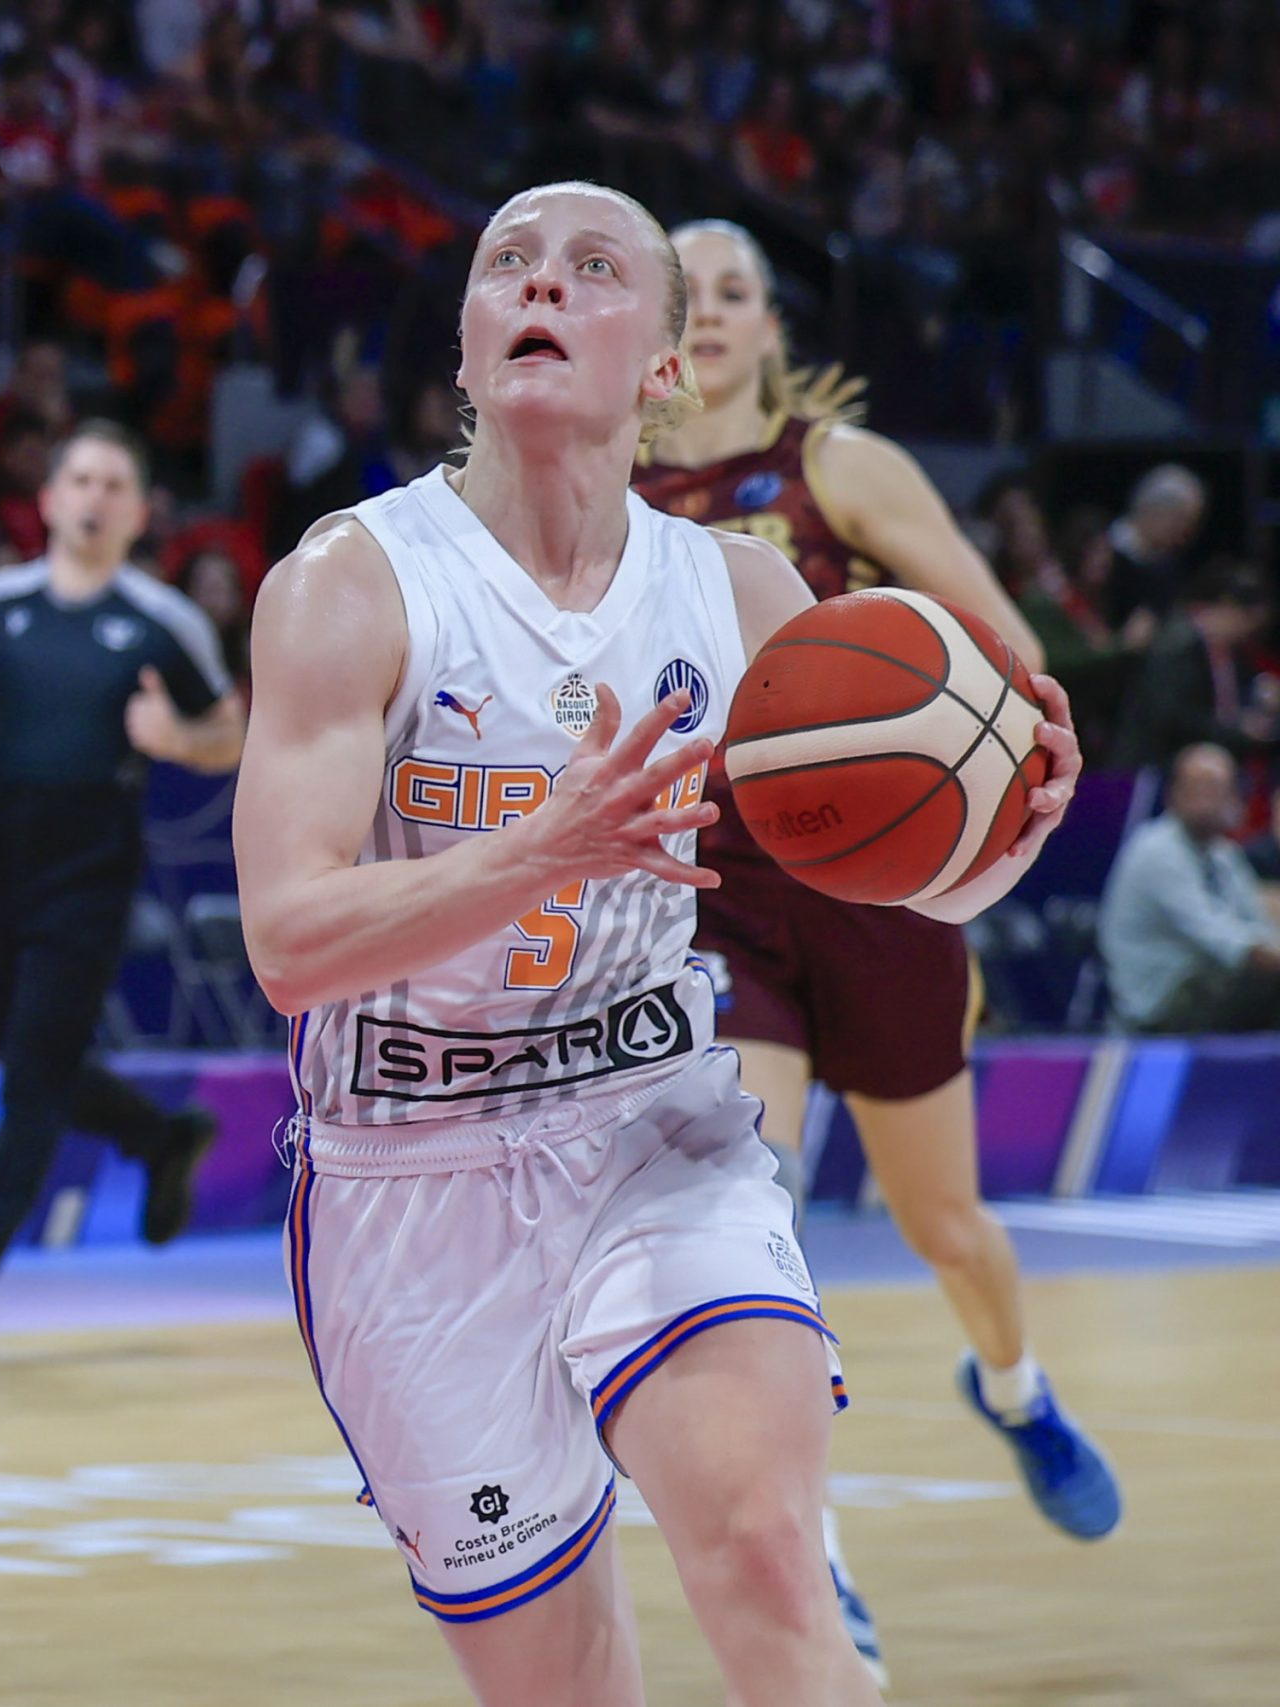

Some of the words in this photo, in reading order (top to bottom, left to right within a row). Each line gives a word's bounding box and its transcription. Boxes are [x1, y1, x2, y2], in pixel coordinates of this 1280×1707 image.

[555, 710, 596, 725] GIRON
[557, 698, 595, 710] BASQUET
[504, 878, 589, 992] 5
[377, 1018, 605, 1086] SPAR
[478, 1492, 502, 1515] G!
[443, 1549, 495, 1570] Pirineu
[498, 1540, 515, 1555] de
[516, 1513, 558, 1544] Girona
[455, 1532, 498, 1552] Costa
[501, 1512, 540, 1538] Brava
